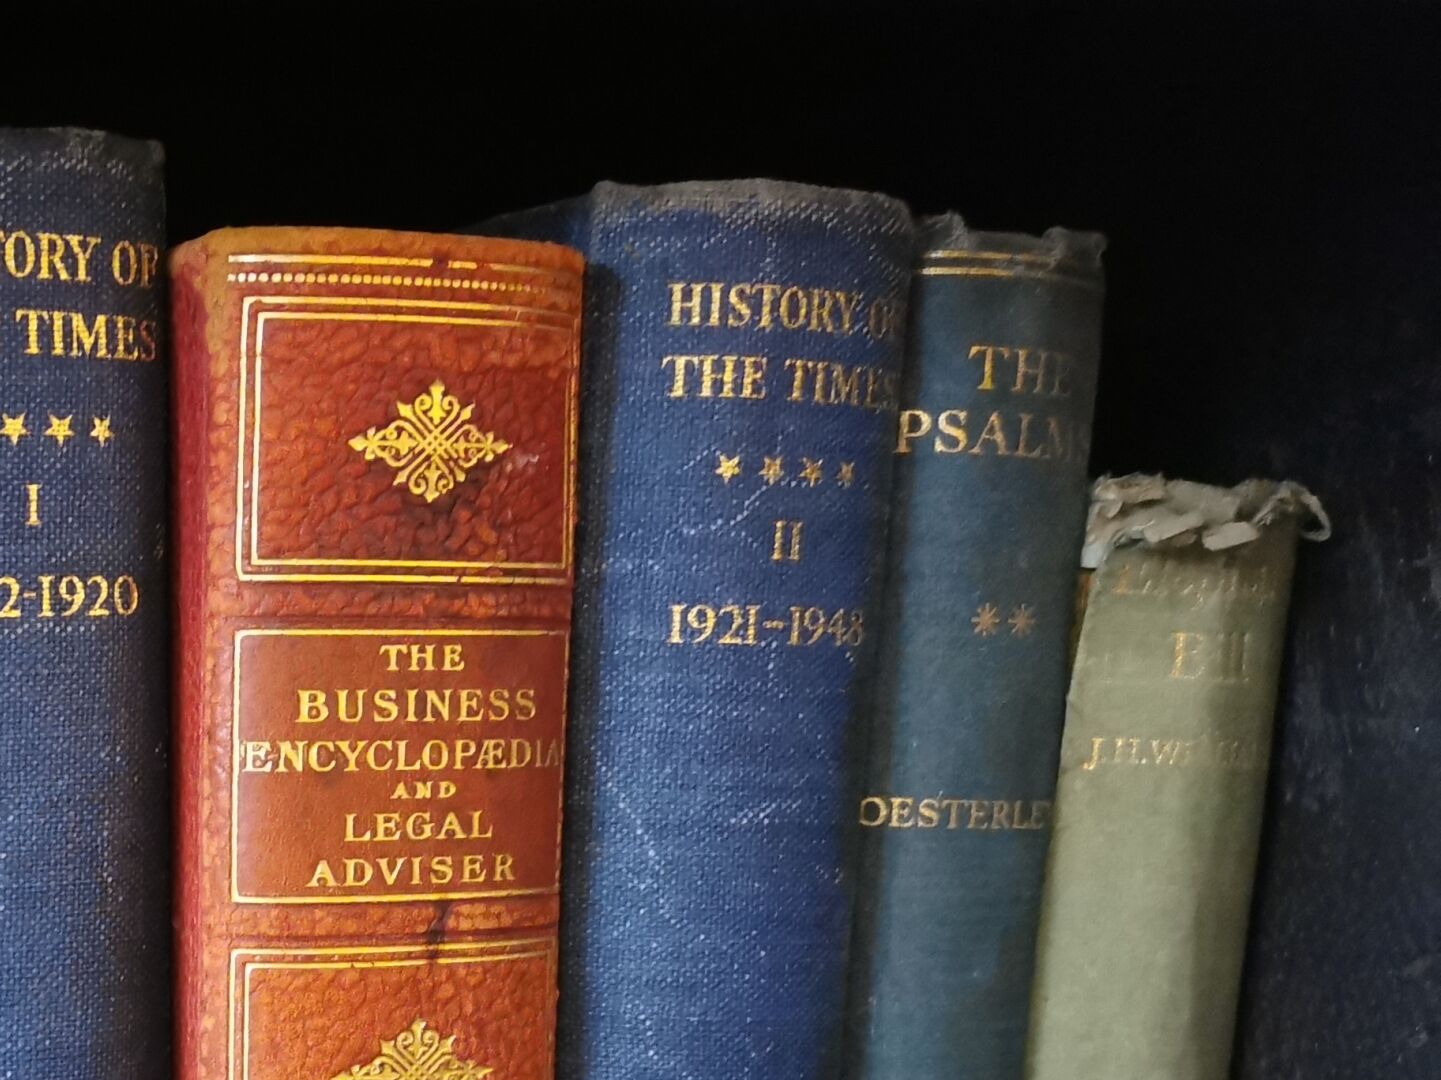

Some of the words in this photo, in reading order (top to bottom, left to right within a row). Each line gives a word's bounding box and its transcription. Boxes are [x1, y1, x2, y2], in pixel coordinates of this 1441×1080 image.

[111, 240, 158, 288] OF
[666, 281, 864, 334] HISTORY
[16, 309, 157, 362] TIMES
[662, 354, 767, 400] THE
[25, 483, 42, 526] I
[770, 519, 804, 561] II
[379, 643, 466, 672] THE
[294, 688, 538, 724] BUSINESS
[239, 739, 561, 774] ENCYCLOPÆDIA
[390, 780, 457, 800] AND
[344, 810, 493, 843] LEGAL
[305, 853, 517, 888] ADVISER
